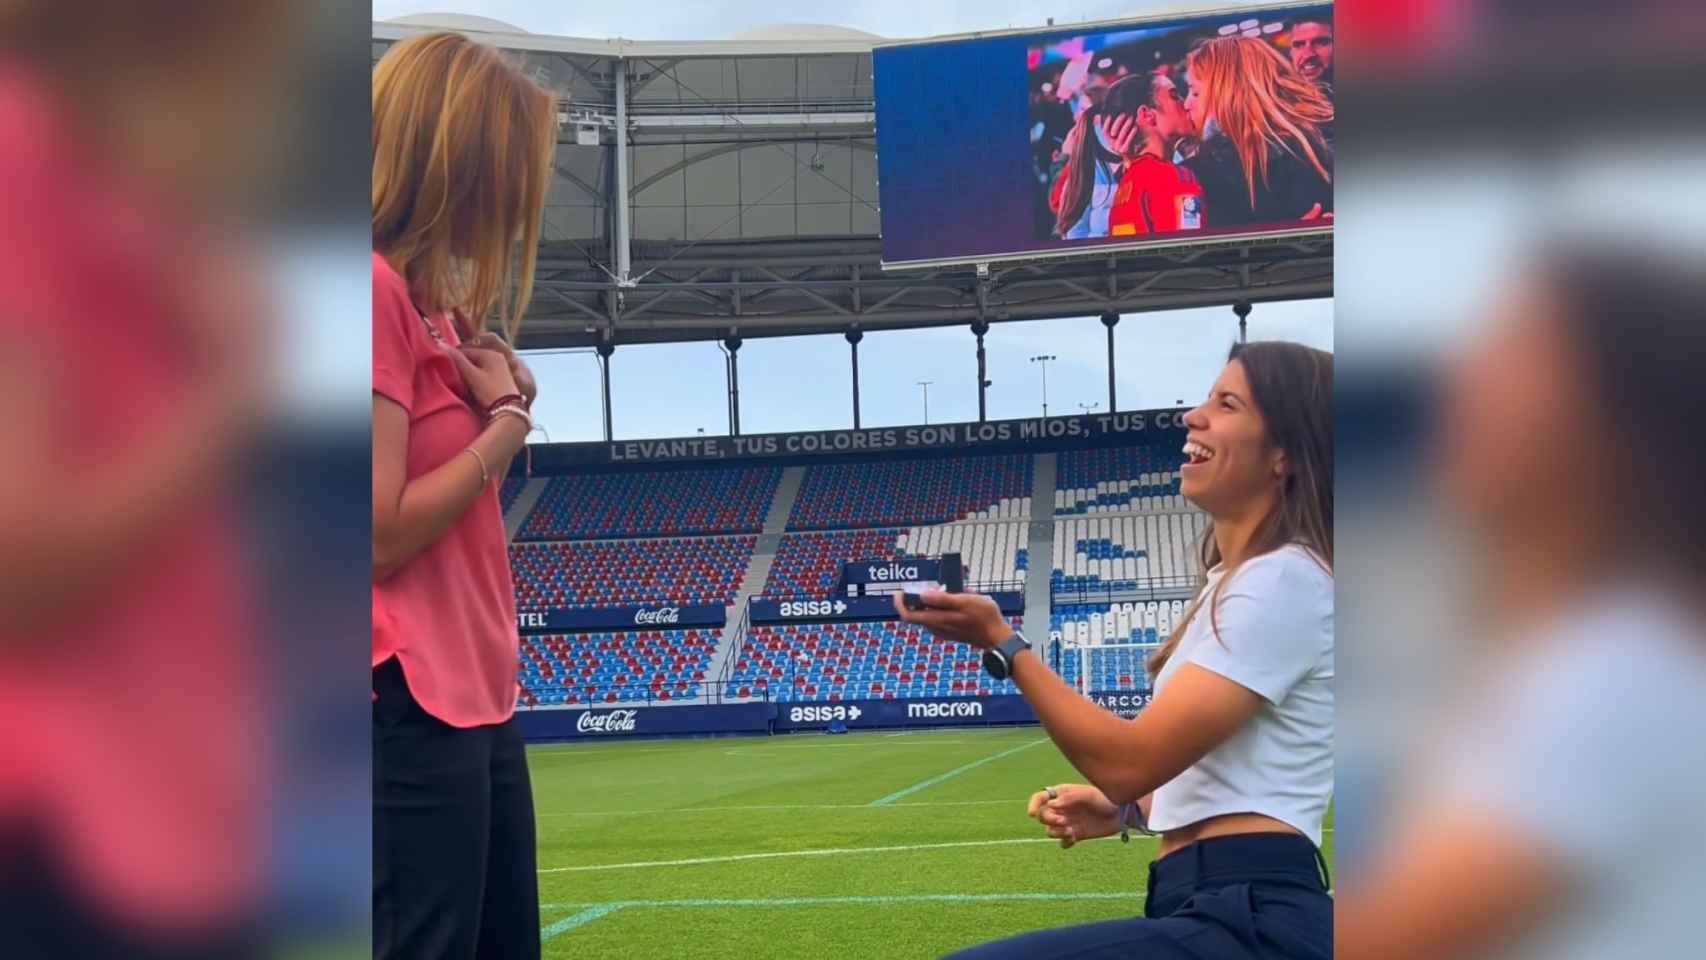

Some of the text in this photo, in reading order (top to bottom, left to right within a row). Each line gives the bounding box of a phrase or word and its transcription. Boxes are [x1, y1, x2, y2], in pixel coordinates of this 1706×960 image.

[611, 440, 725, 461] LEVANTE,
[734, 436, 777, 454] TUS
[786, 430, 897, 450] COLORES
[906, 426, 956, 445] SON
[966, 422, 1011, 442] LOS
[1098, 413, 1146, 433] TUS
[868, 563, 918, 581] teika
[908, 702, 983, 718] macron
